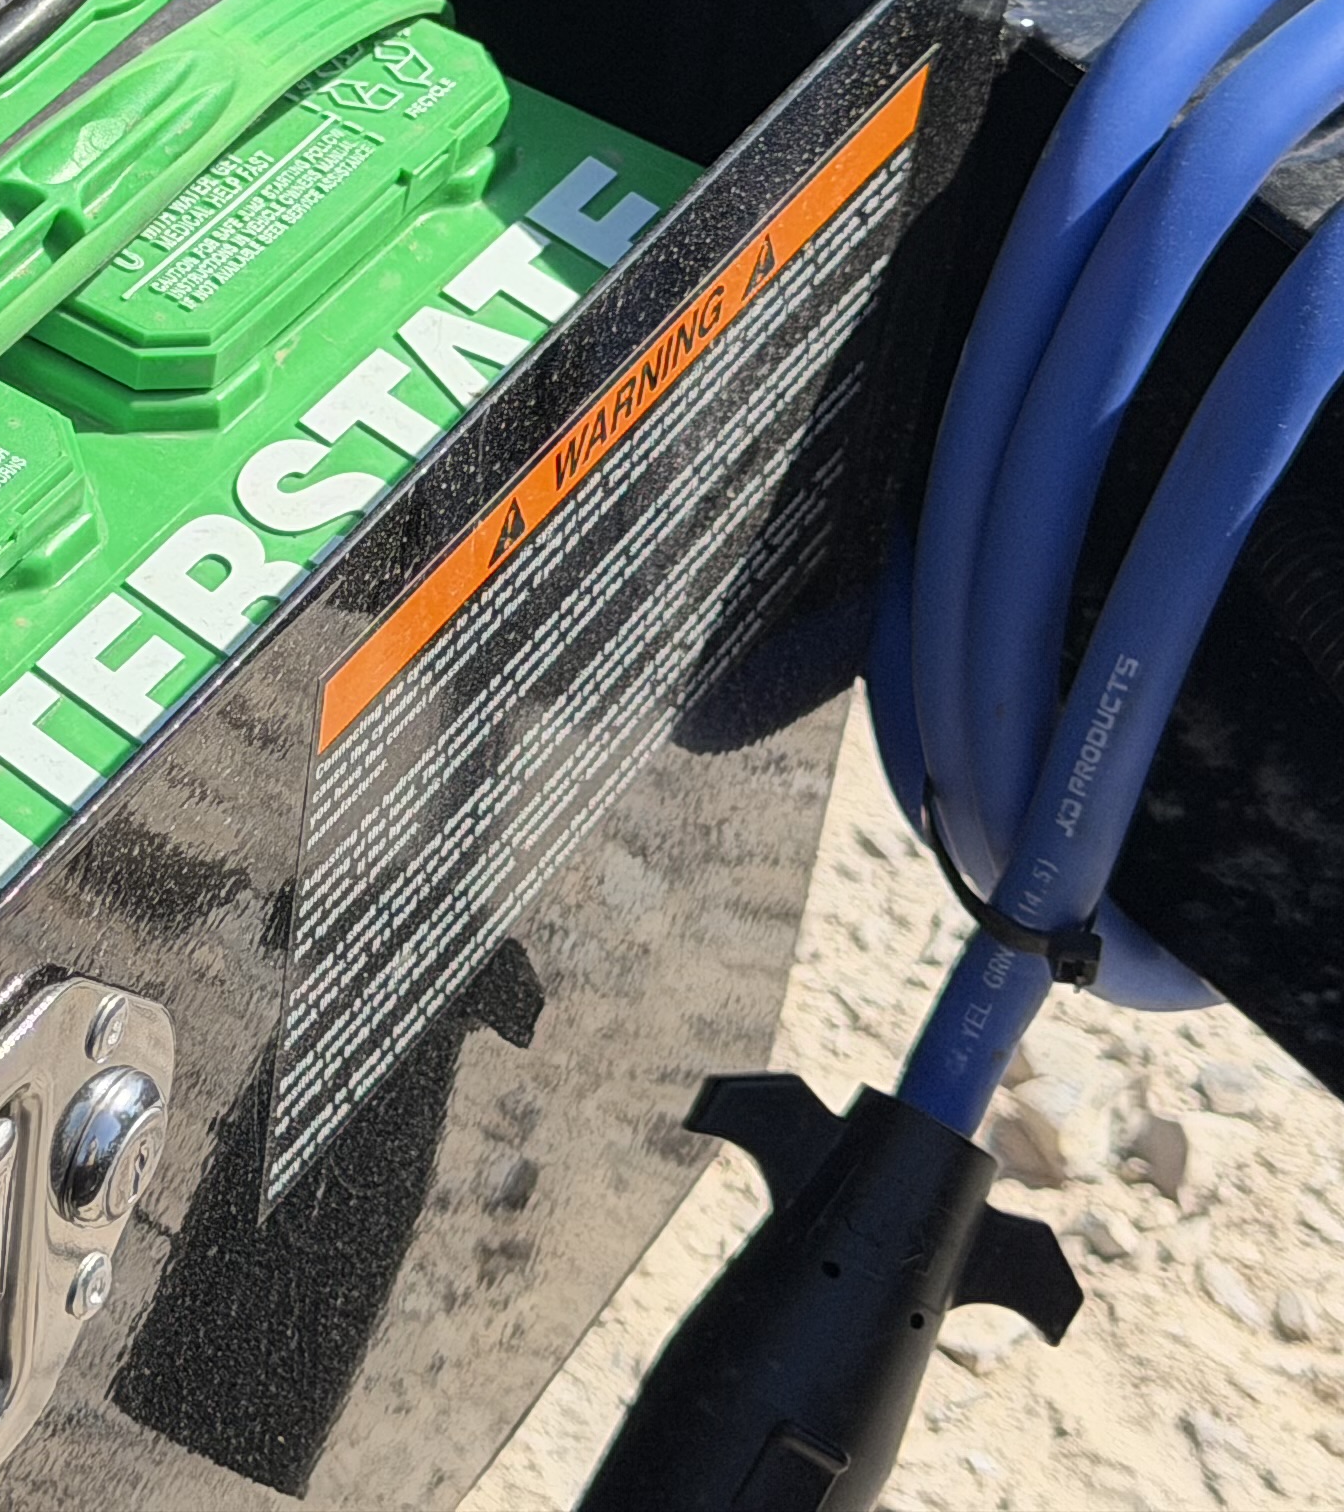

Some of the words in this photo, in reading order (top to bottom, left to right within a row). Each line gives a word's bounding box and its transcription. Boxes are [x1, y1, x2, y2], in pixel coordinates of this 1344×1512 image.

[405, 77, 456, 118] RECYCLE
[151, 205, 215, 250] MEDICAL
[203, 176, 243, 208] HELP
[234, 149, 275, 182] FAST
[555, 285, 725, 491] WARNING
[1068, 653, 1138, 798] PRODUCTS
